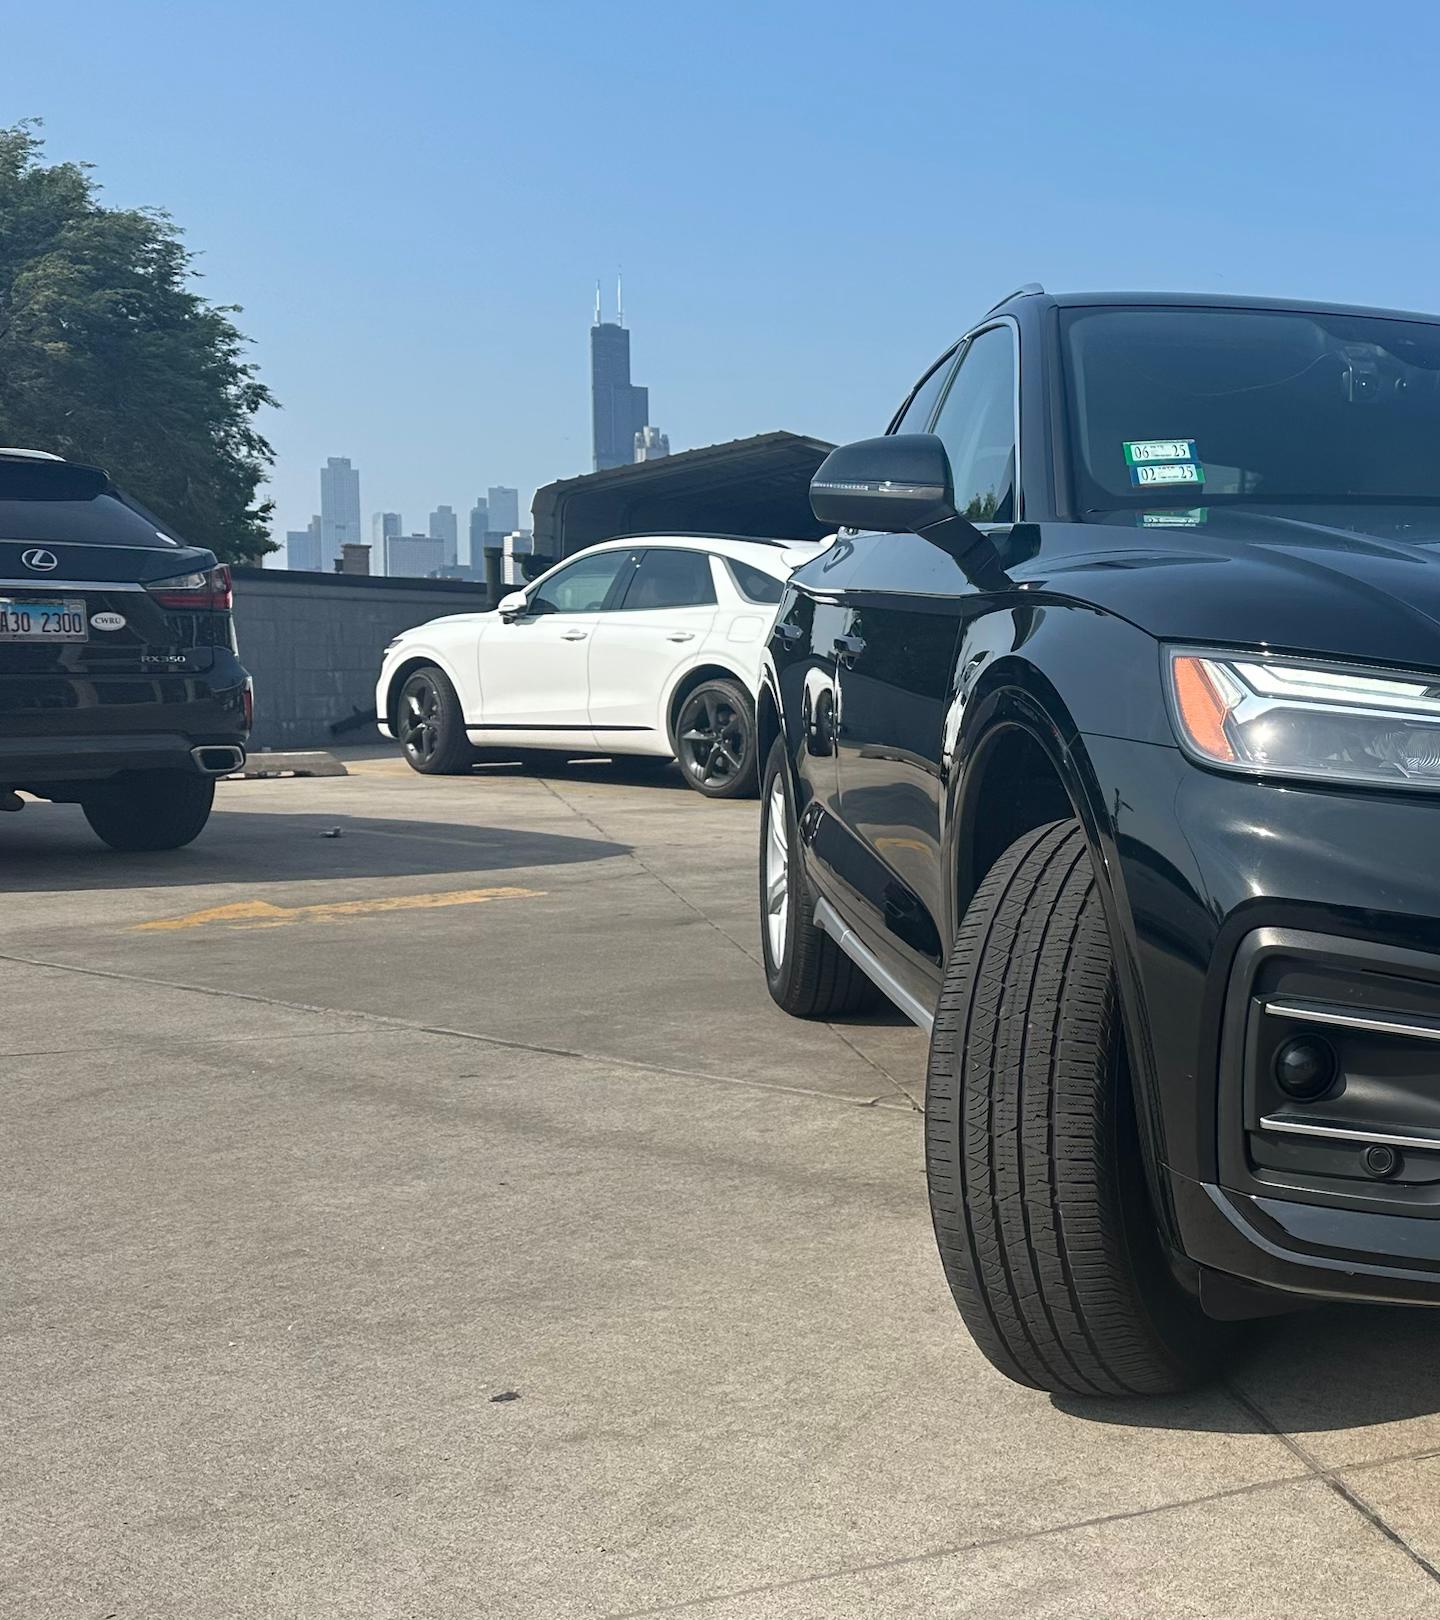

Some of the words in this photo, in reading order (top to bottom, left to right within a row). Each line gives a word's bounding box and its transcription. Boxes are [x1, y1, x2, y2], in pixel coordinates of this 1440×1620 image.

[1134, 446, 1150, 459] 06
[1172, 444, 1186, 457] 25
[1141, 467, 1157, 481] 02
[1179, 465, 1194, 479] 25
[41, 612, 82, 633] 2300
[94, 615, 121, 625] CWRU
